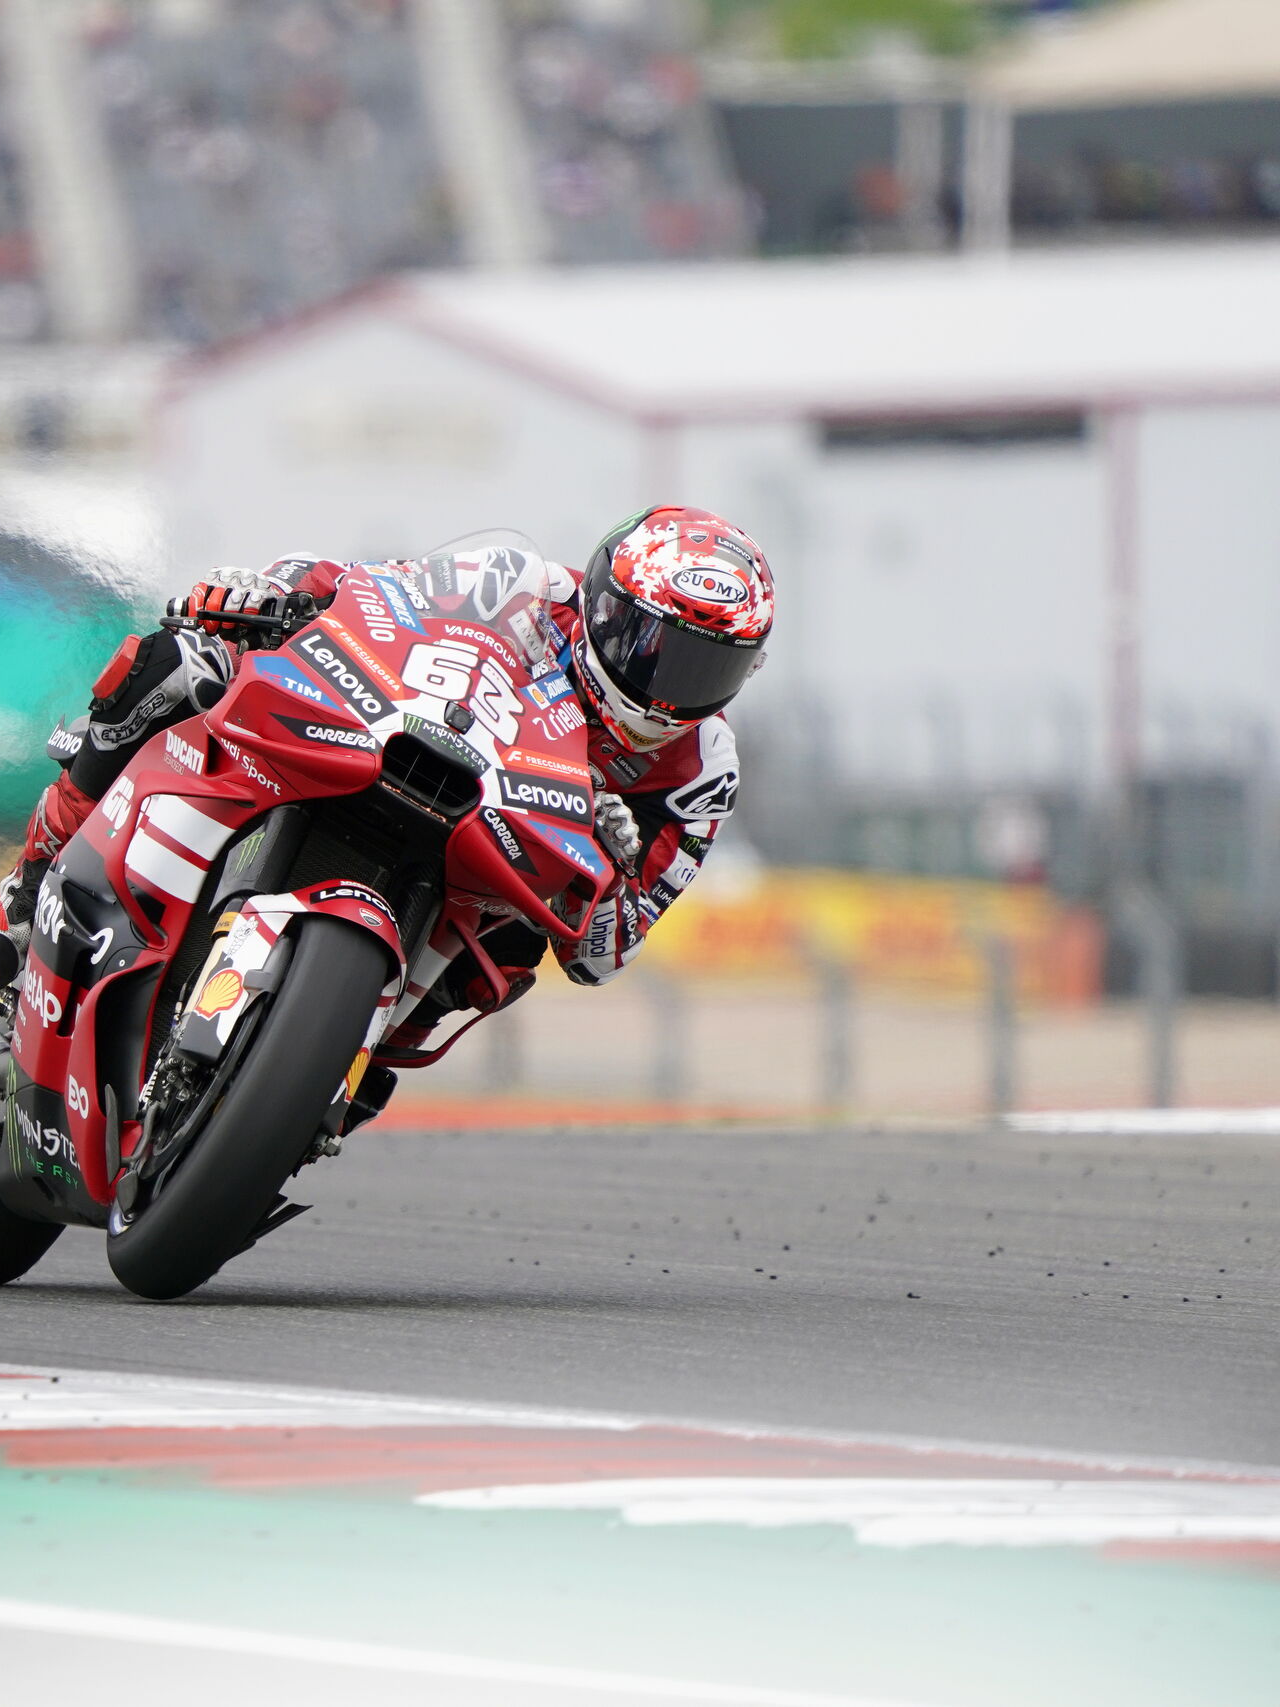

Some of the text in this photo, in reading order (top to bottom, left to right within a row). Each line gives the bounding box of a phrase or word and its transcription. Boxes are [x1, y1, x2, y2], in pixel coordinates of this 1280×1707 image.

[718, 537, 751, 560] Lenovo
[634, 599, 663, 618] CARRERA
[681, 571, 744, 602] SUOMY
[444, 624, 517, 669] VARGROUP
[685, 623, 717, 637] MONSTER
[300, 634, 382, 714] Lenovo
[339, 632, 401, 691] FRECCIAROSSA
[575, 639, 601, 697] Lenovo
[284, 677, 322, 701] TIM
[401, 640, 526, 746] 63
[48, 724, 82, 754] Lenovo
[166, 730, 204, 775] DUCATI
[305, 725, 377, 750] CARRERA
[423, 722, 487, 771] MONSTER
[221, 738, 281, 796] udi Sport
[526, 755, 589, 777] FRECCIAROSSA
[503, 776, 587, 815] Lenovo
[483, 808, 522, 860] CARRERA
[320, 888, 401, 940] Lenov
[590, 910, 615, 958] Unipol
[24, 953, 70, 1032] NetAp
[15, 1103, 81, 1170] MONSTE
